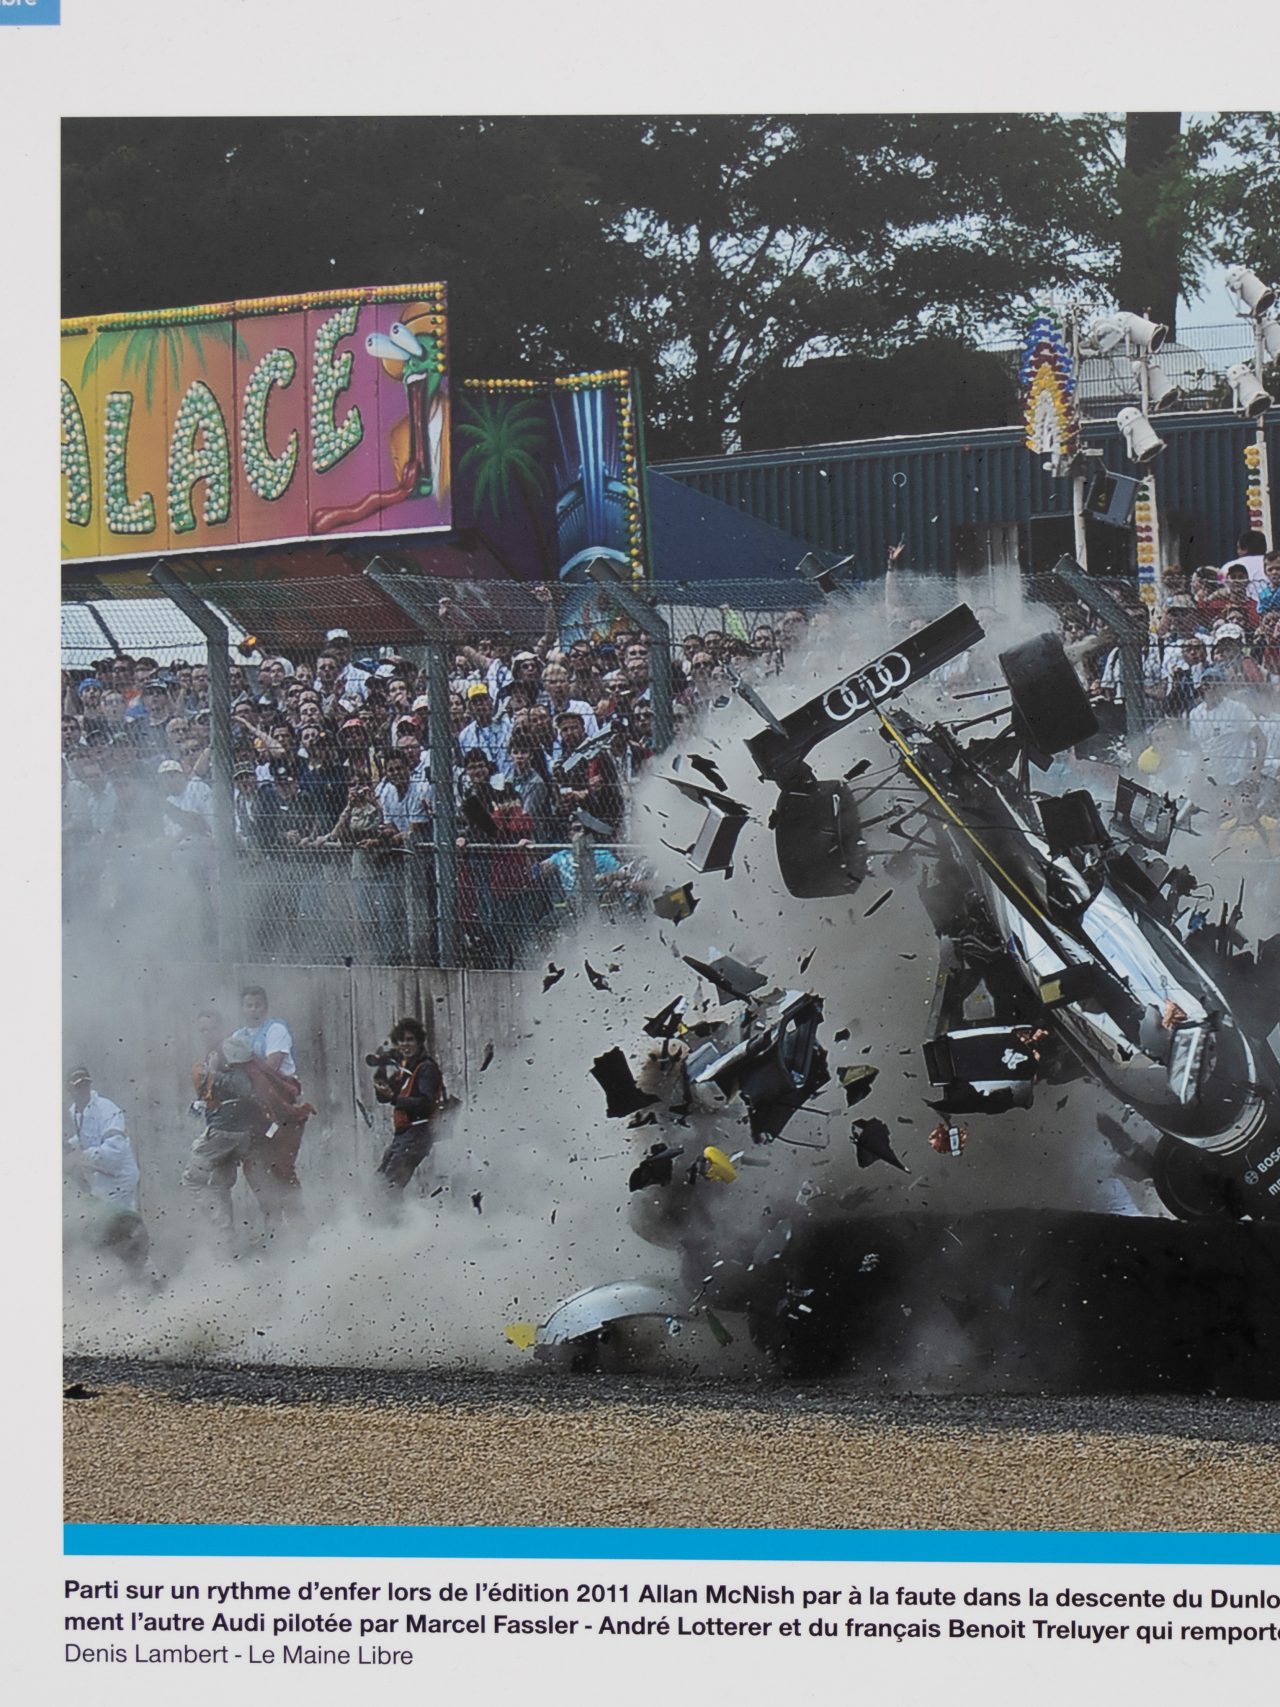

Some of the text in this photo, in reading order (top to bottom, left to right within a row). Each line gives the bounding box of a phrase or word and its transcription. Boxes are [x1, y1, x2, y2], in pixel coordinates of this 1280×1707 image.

[64, 1579, 119, 1599] Parti
[126, 1584, 165, 1600] sur
[171, 1585, 200, 1600] un
[207, 1580, 291, 1605] rythme
[298, 1581, 382, 1601] d’enfer
[388, 1582, 432, 1602] lors
[438, 1582, 469, 1602] de
[475, 1582, 569, 1603] l’édition
[576, 1583, 628, 1603] 2011
[638, 1584, 698, 1604] Allan
[706, 1584, 795, 1605] McNish
[802, 1590, 843, 1609] par
[848, 1585, 862, 1606] à
[869, 1586, 889, 1606] la
[895, 1586, 956, 1606] faute
[963, 1587, 1022, 1607] dans
[1029, 1587, 1049, 1607] la
[1055, 1587, 1166, 1608] descente
[1172, 1588, 1203, 1609] du
[64, 1612, 124, 1631] ment
[131, 1612, 205, 1632] l’autre
[211, 1612, 265, 1632] Audi
[273, 1612, 353, 1637] pilotée
[360, 1618, 400, 1637] par
[406, 1614, 486, 1634] Marcel
[494, 1614, 579, 1635] Fassler
[598, 1615, 670, 1636] André
[678, 1616, 773, 1637] Lotterer
[778, 1618, 802, 1637] et
[808, 1617, 838, 1637] du
[844, 1617, 941, 1643] français
[948, 1618, 1026, 1639] Benoit
[1032, 1619, 1130, 1644] Treluyer
[1136, 1620, 1173, 1645] qui
[65, 1643, 128, 1663] Denis
[135, 1644, 229, 1664] Lambert
[249, 1644, 275, 1664] Le
[283, 1645, 351, 1665] Maine
[358, 1645, 414, 1665] Libre
